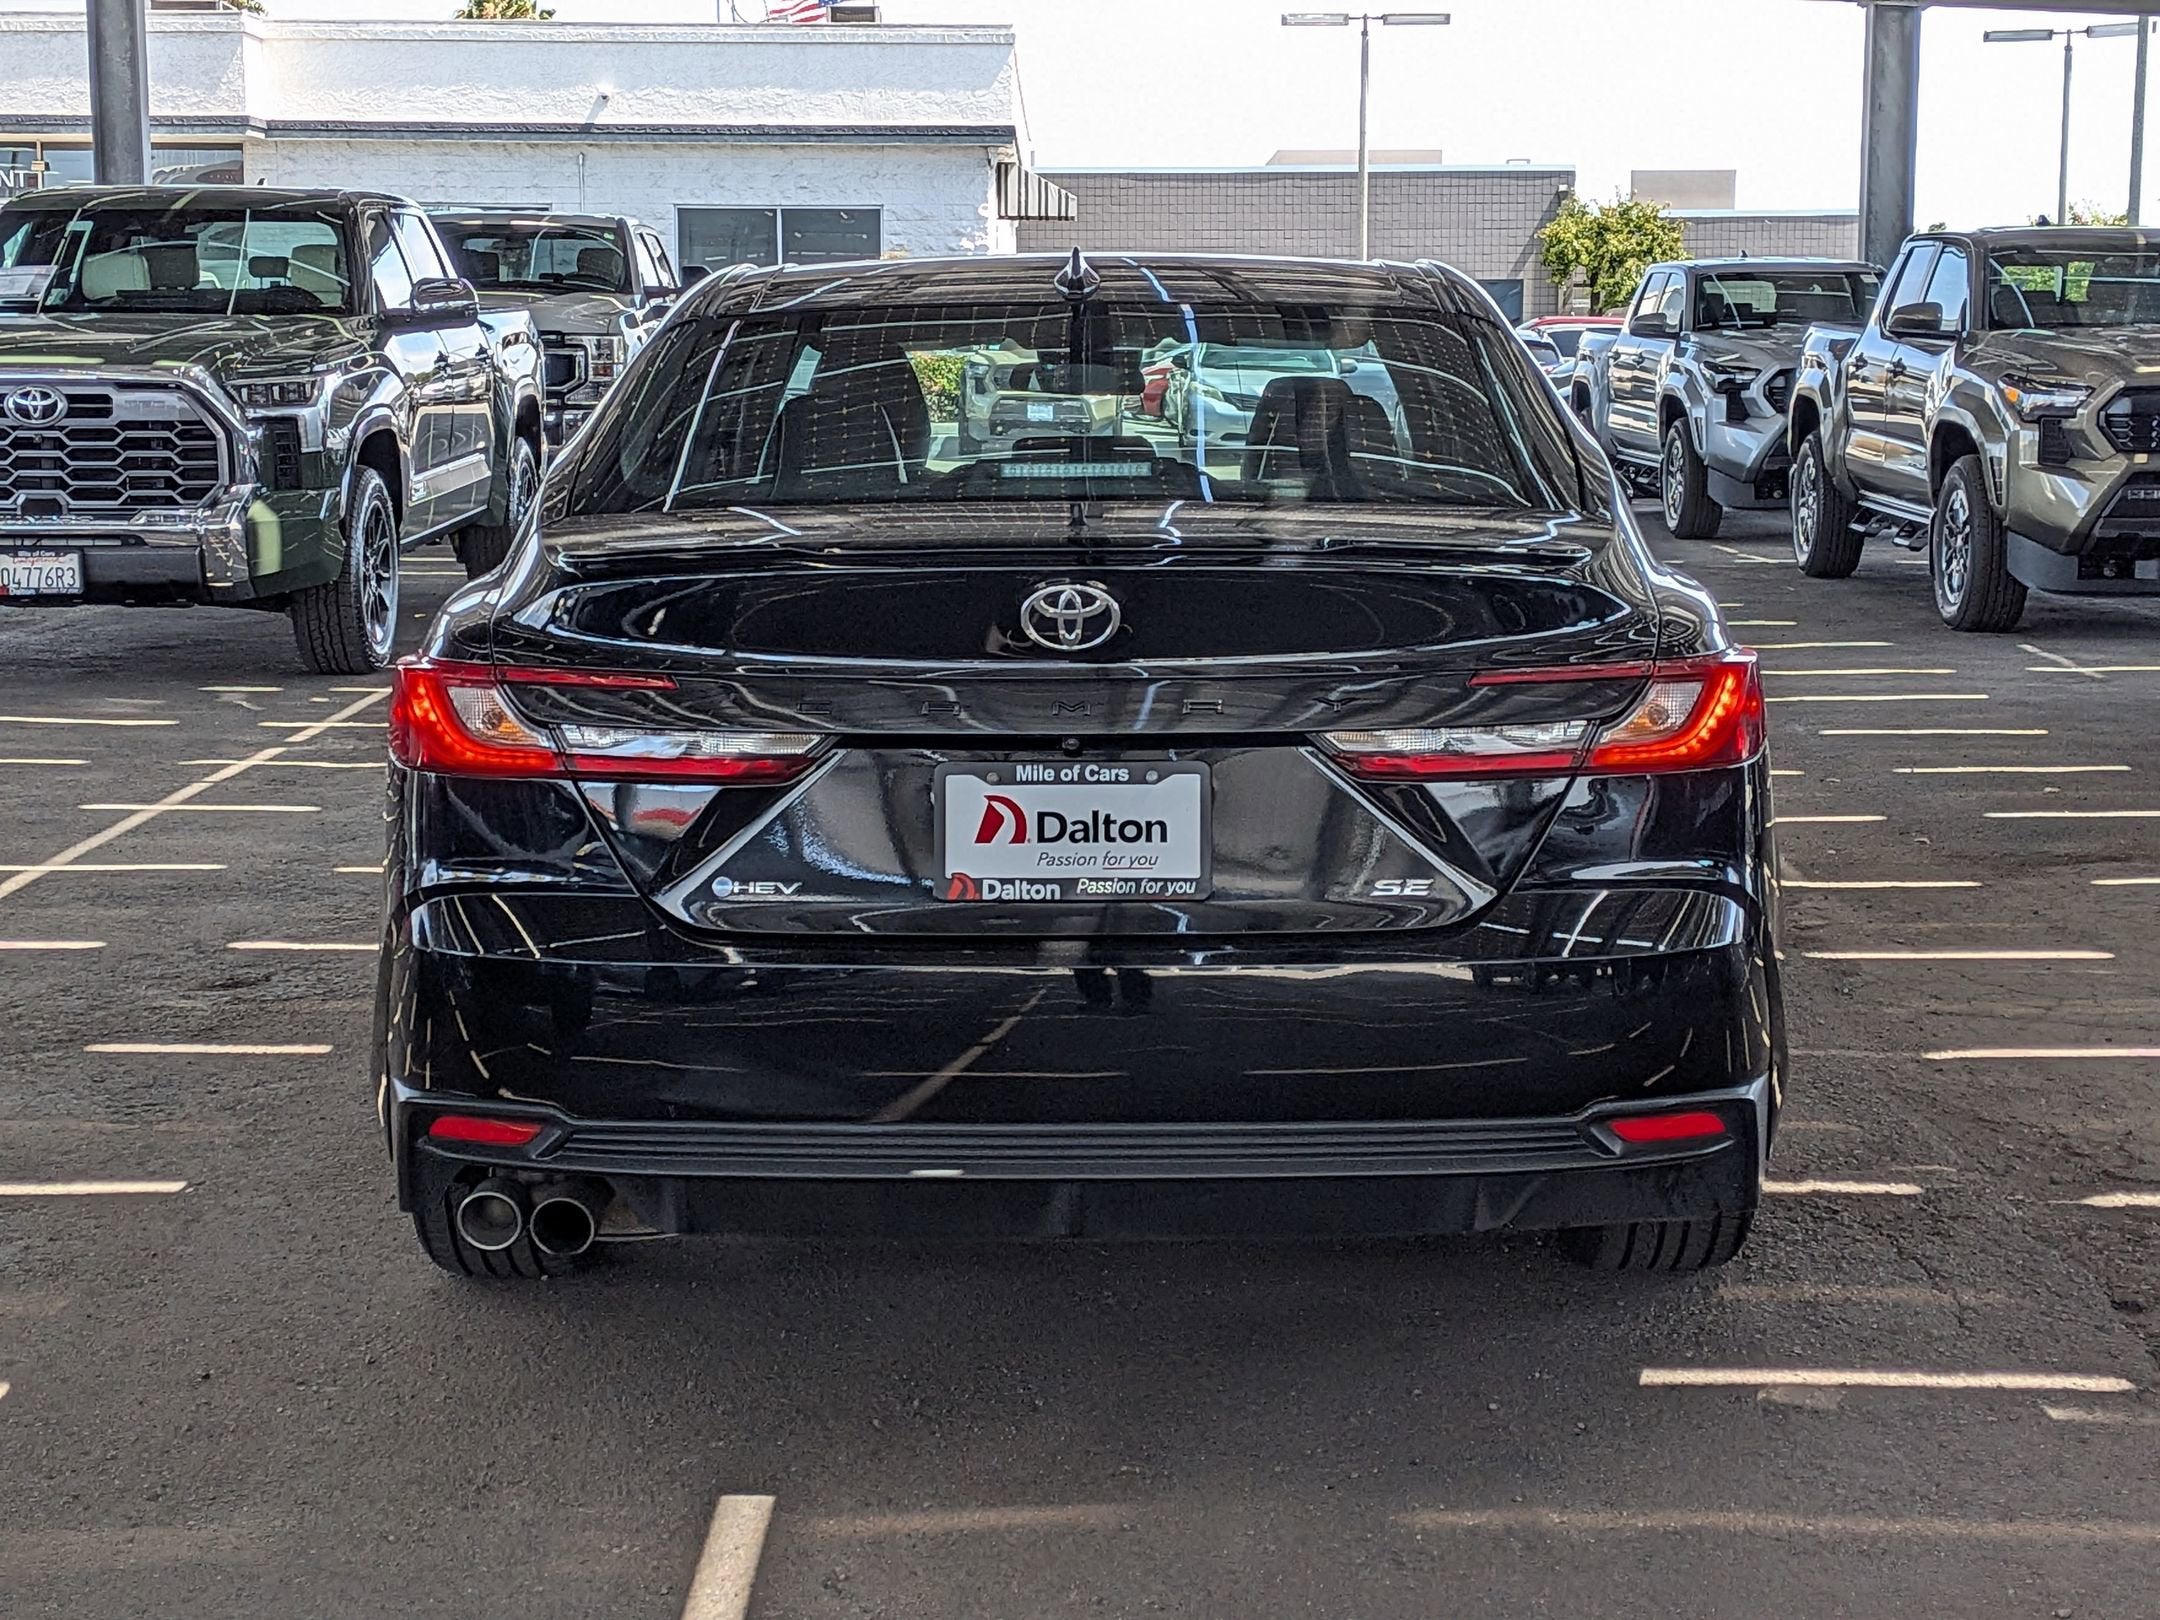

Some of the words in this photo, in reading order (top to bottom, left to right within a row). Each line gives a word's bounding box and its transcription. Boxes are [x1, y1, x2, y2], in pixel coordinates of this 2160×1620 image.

[1, 566, 76, 590] 04776R3
[796, 697, 1361, 716] CAMRY
[1015, 765, 1055, 782] Mile
[1060, 765, 1081, 782] of
[1084, 764, 1130, 782] Cars
[1037, 810, 1168, 843] Dalton
[1036, 852, 1098, 867] Passion
[1102, 850, 1126, 867] for
[1127, 855, 1159, 869] you
[733, 881, 803, 895] HEV
[982, 879, 1061, 900] Dalton
[1076, 878, 1136, 894] Passion
[1139, 878, 1165, 894] for
[1164, 880, 1197, 897] you
[1369, 879, 1434, 896] SE
